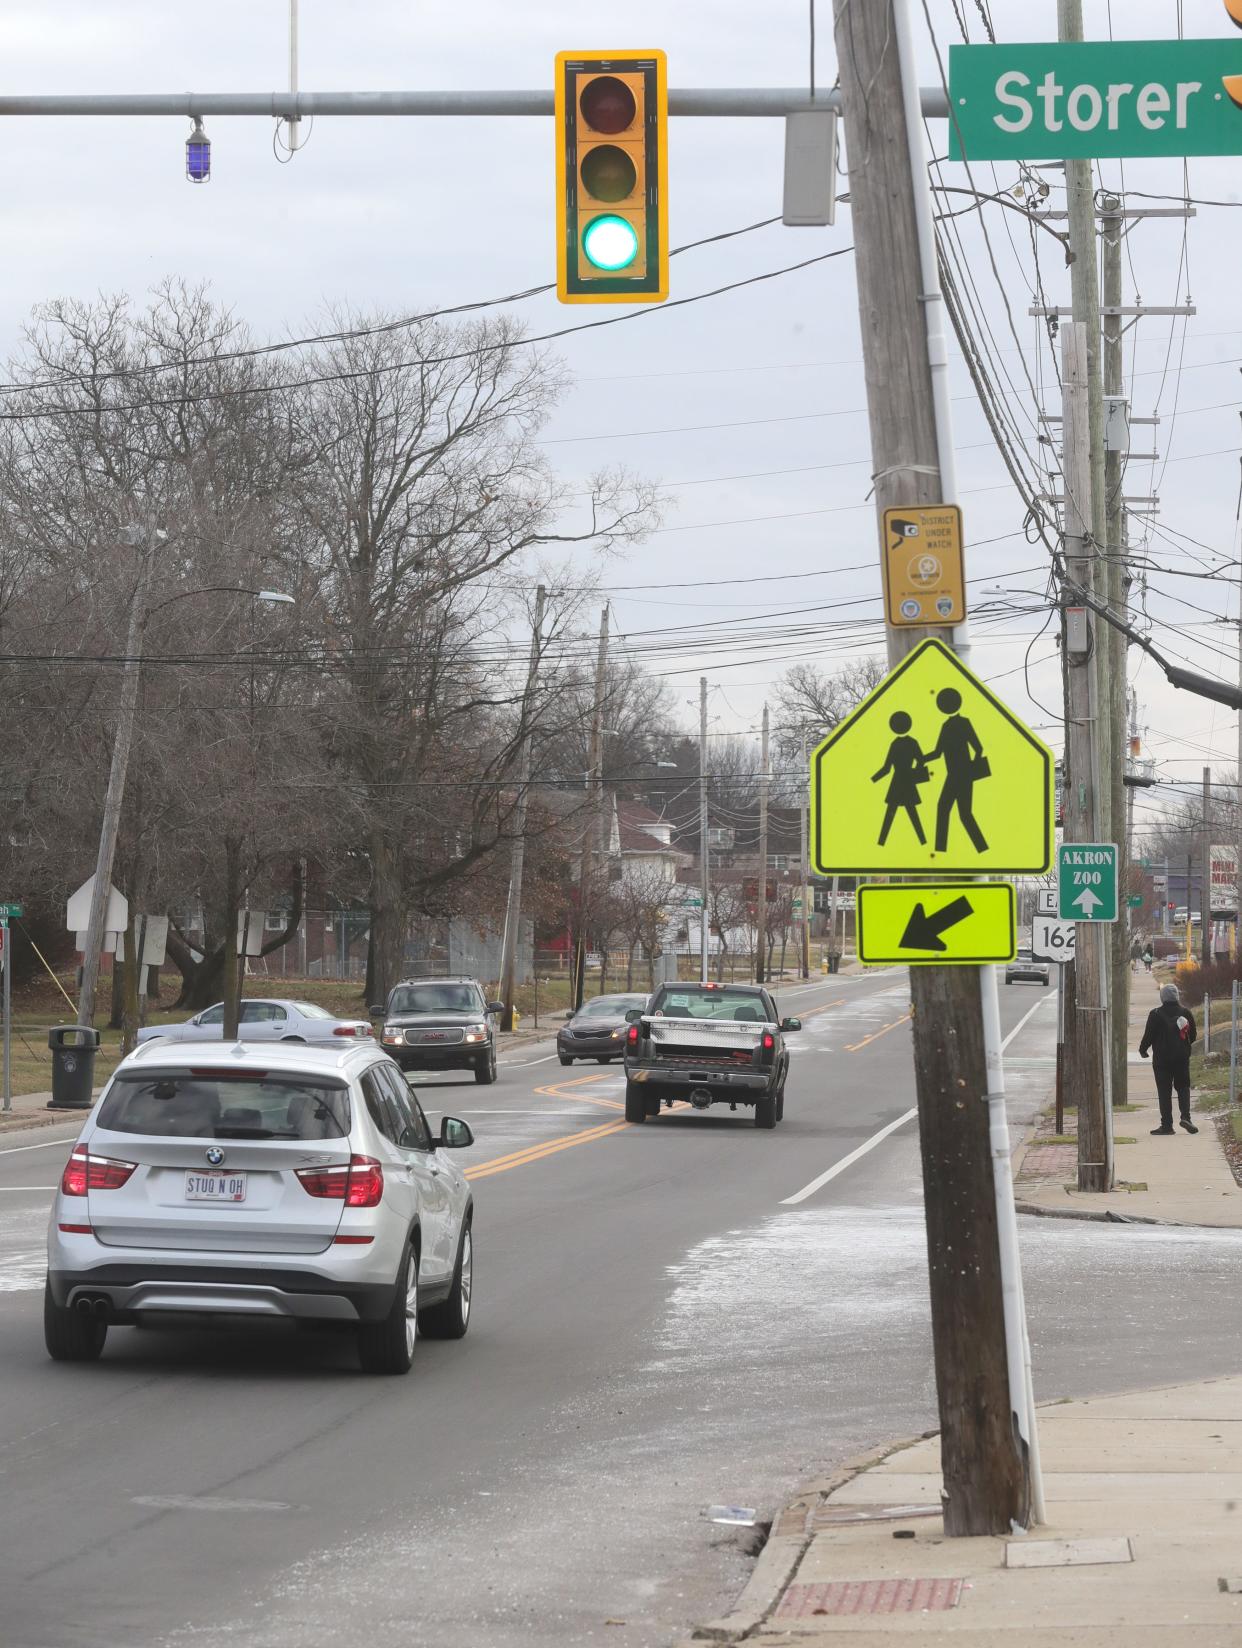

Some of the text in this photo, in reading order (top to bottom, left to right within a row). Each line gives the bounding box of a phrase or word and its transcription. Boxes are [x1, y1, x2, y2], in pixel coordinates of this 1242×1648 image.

[993, 70, 1203, 133] Storer
[921, 516, 954, 526] DISTRICT
[925, 528, 952, 537] UNDER
[926, 540, 952, 549] WATCH
[1062, 851, 1113, 865] AKRON
[1212, 861, 1234, 872] MINI
[1073, 871, 1102, 885] ZOO
[1043, 926, 1076, 948] 162
[187, 1177, 243, 1194] STUQ N OH
